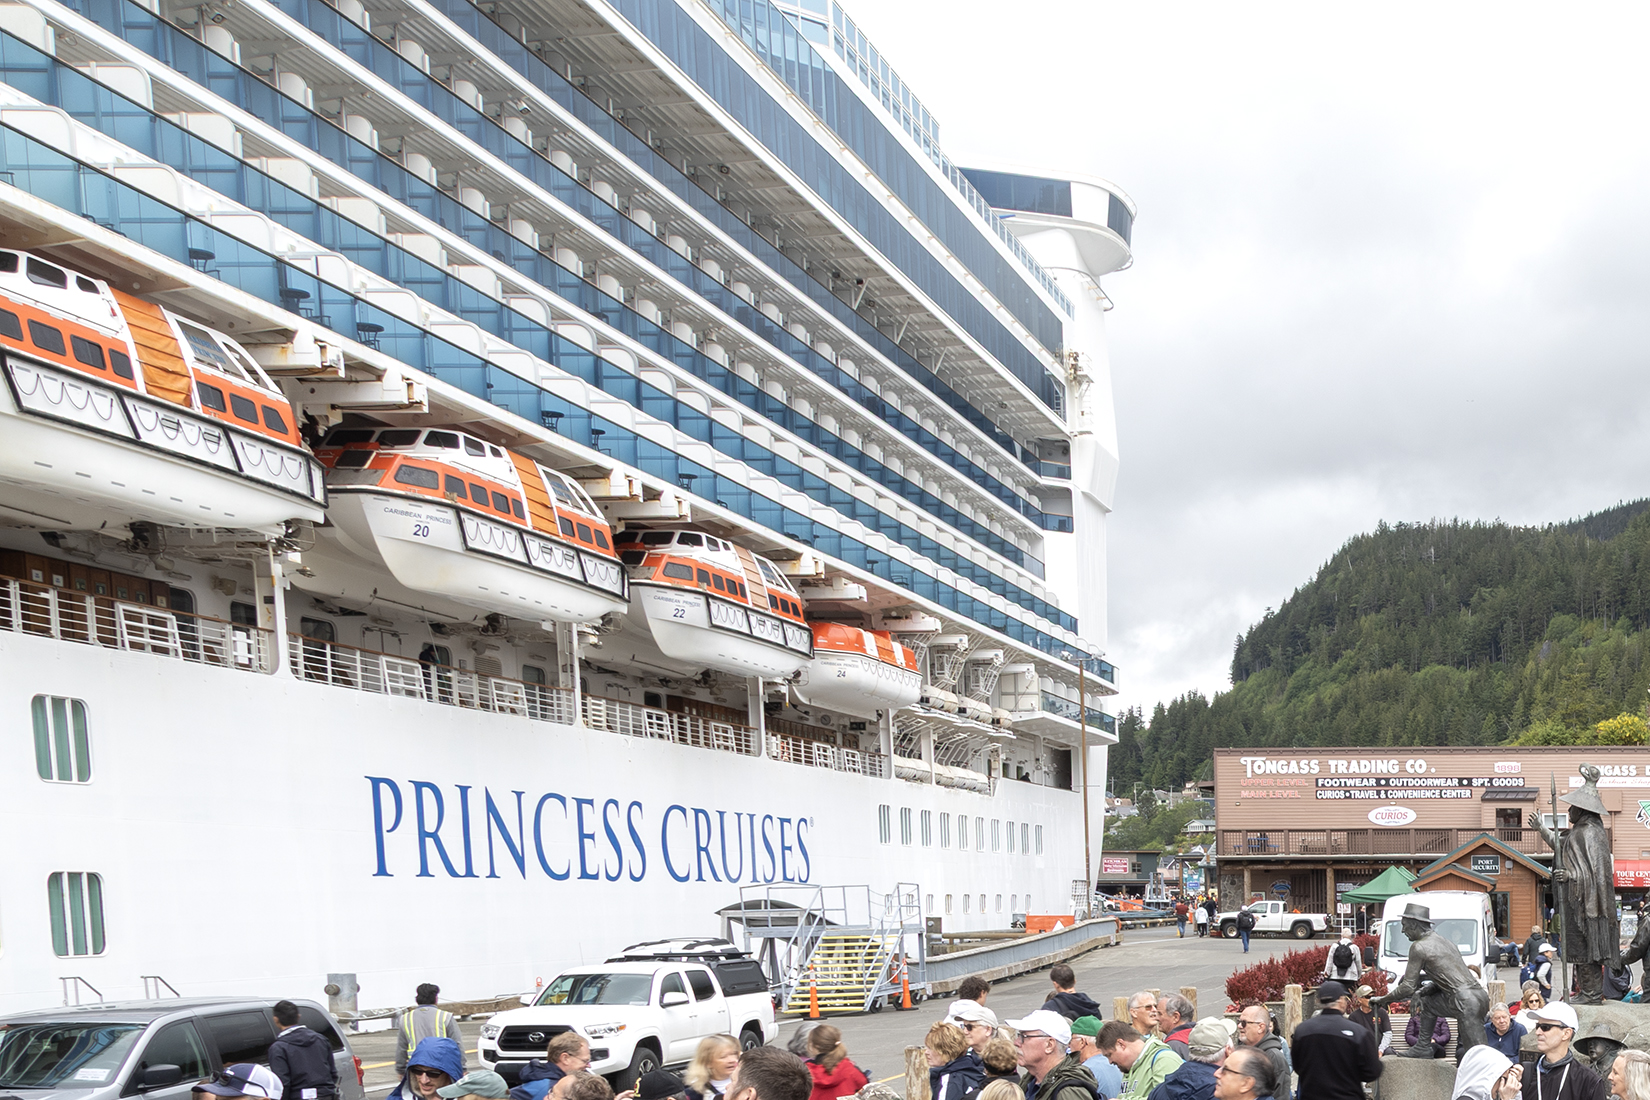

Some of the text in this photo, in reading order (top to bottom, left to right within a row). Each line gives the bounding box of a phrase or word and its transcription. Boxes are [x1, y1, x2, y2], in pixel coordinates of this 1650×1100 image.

[383, 507, 452, 525] CARIBBEAN PRINCESS
[413, 524, 430, 538] 20
[653, 595, 681, 604] CARIBBEAN
[673, 608, 686, 619] 22
[836, 670, 846, 678] 24
[1240, 757, 1320, 778] TONGASS
[1328, 760, 1399, 774] TRADING
[1496, 764, 1520, 772] 1898
[1595, 765, 1637, 776] NGASS
[1240, 779, 1308, 787] UPPER LEVEL
[1318, 778, 1524, 787] FOOTWEAR OUTDOORWEAR SPT. GOODS
[1240, 790, 1302, 798] MAIN LEVEL
[1316, 790, 1471, 799] CURIOS TRAVEL & CONVENIENCE CENTER
[1375, 811, 1408, 821] CURIOS
[364, 775, 646, 882] PRINCESS
